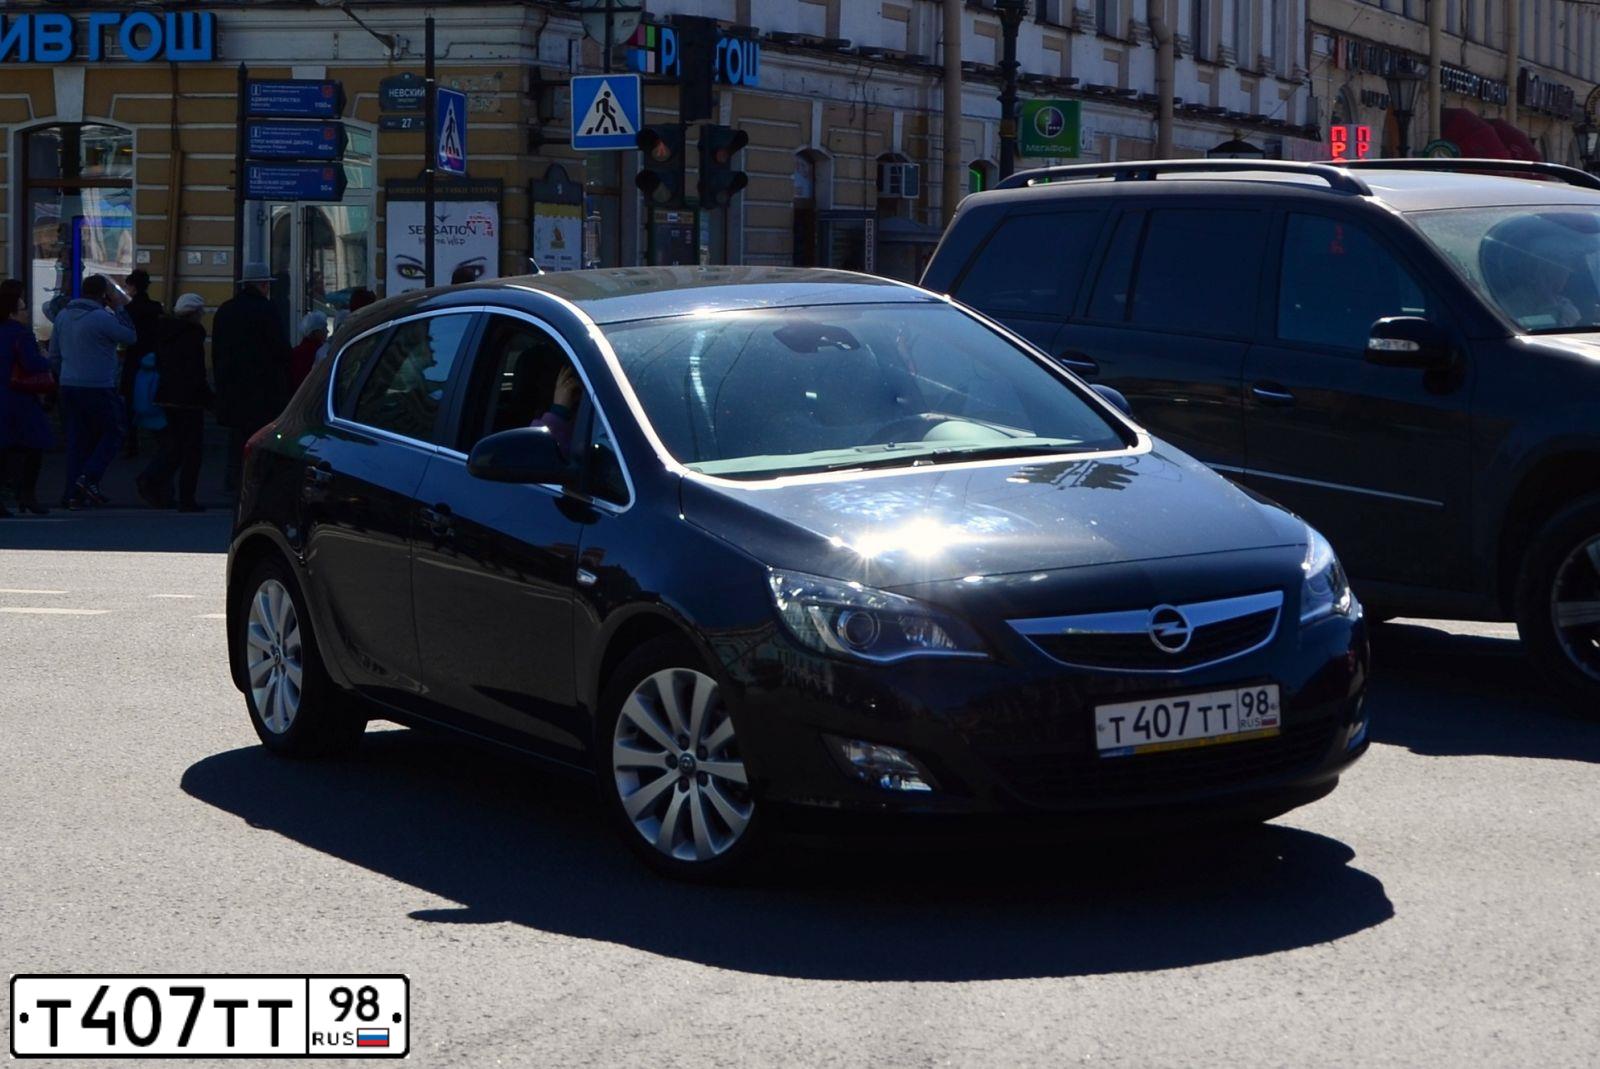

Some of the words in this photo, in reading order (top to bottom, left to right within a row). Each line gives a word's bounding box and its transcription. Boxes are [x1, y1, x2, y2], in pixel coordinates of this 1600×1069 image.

[88, 11, 213, 63] ГОШ
[388, 86, 426, 98] НЕВСКИЙ
[401, 117, 412, 129] 27
[408, 225, 476, 236] SESATION
[1241, 691, 1269, 718] 98
[1240, 717, 1260, 729] RUS
